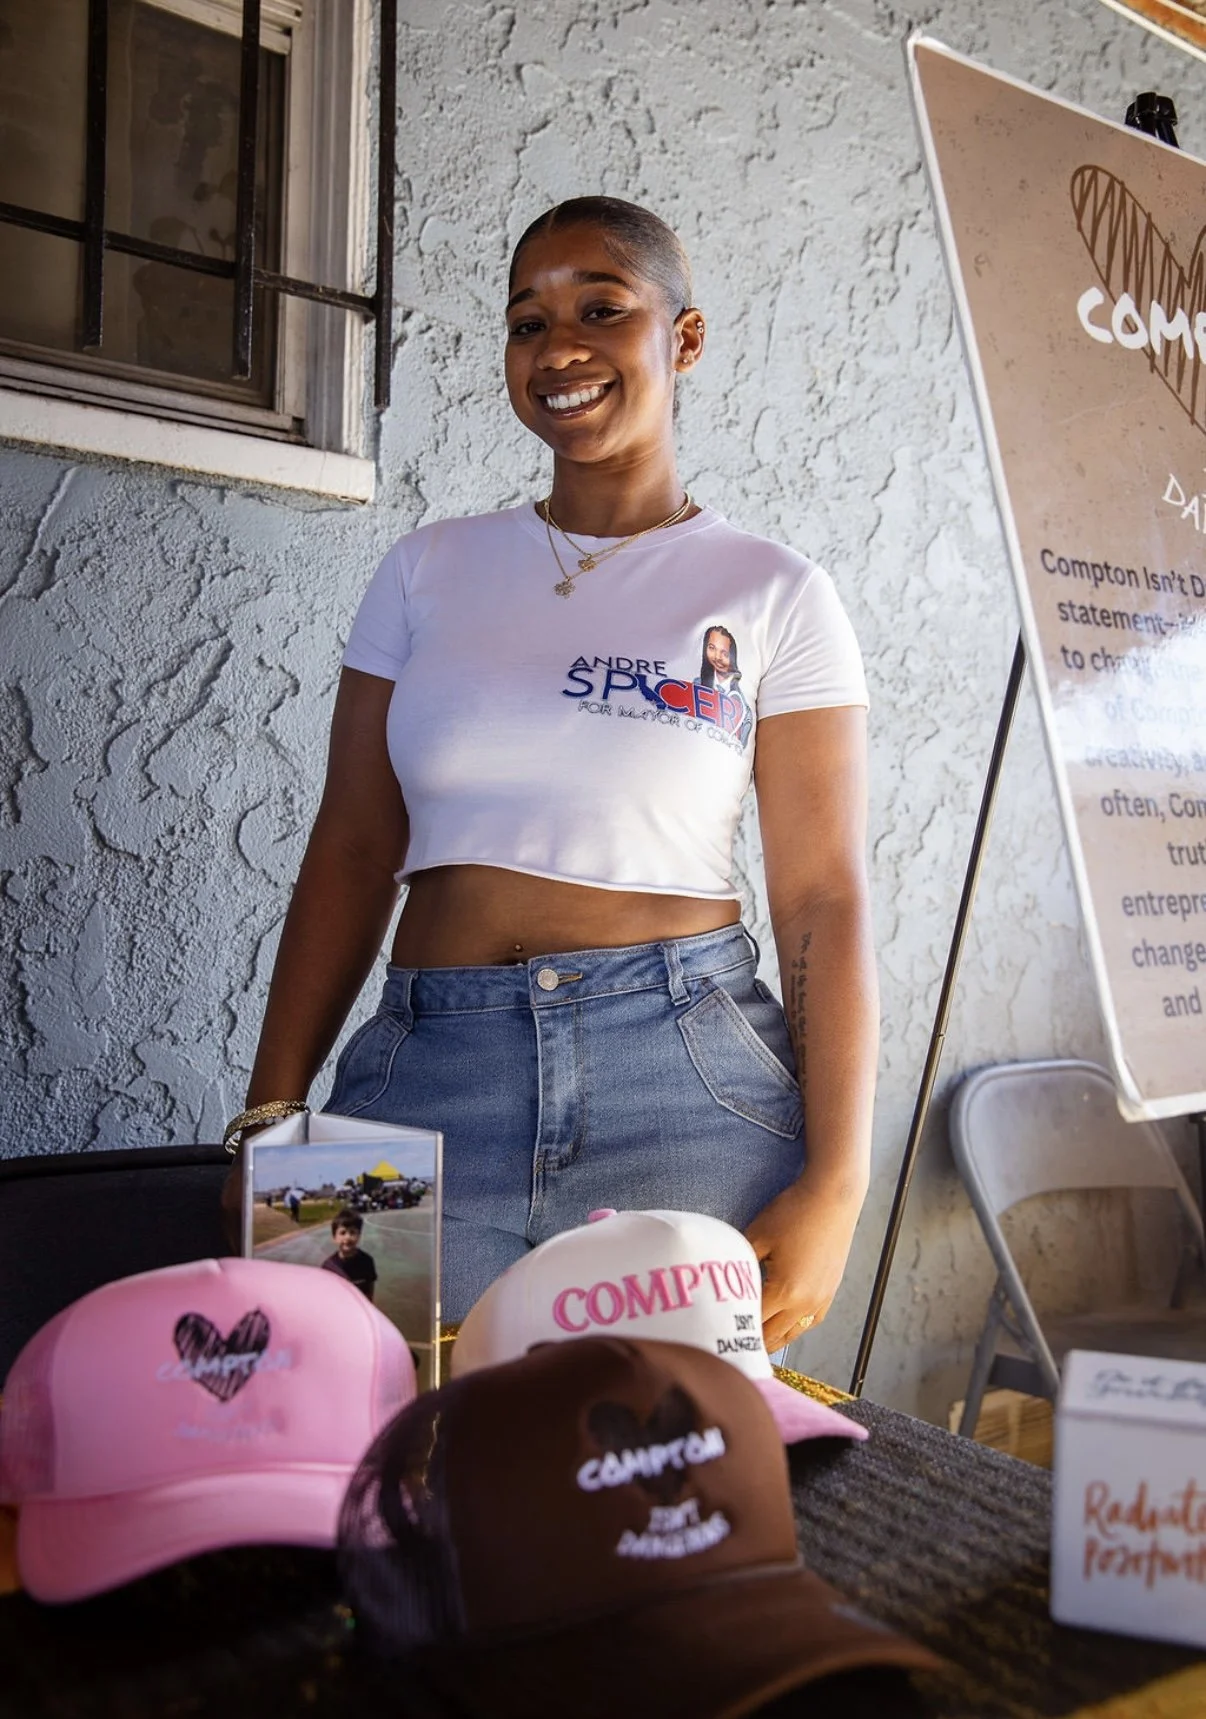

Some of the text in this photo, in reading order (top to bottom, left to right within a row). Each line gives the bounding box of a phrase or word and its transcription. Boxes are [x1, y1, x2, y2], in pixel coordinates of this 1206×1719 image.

[1040, 548, 1140, 588] Compton
[1143, 566, 1188, 597] Isn't
[570, 656, 667, 677] ANDRE
[1061, 644, 1085, 671] to
[577, 700, 612, 716] FOR
[685, 719, 703, 733] OF
[1101, 789, 1166, 823] often,
[1162, 985, 1203, 1017] and
[552, 1259, 759, 1333] COMPTON
[576, 1425, 726, 1492] COMPTON
